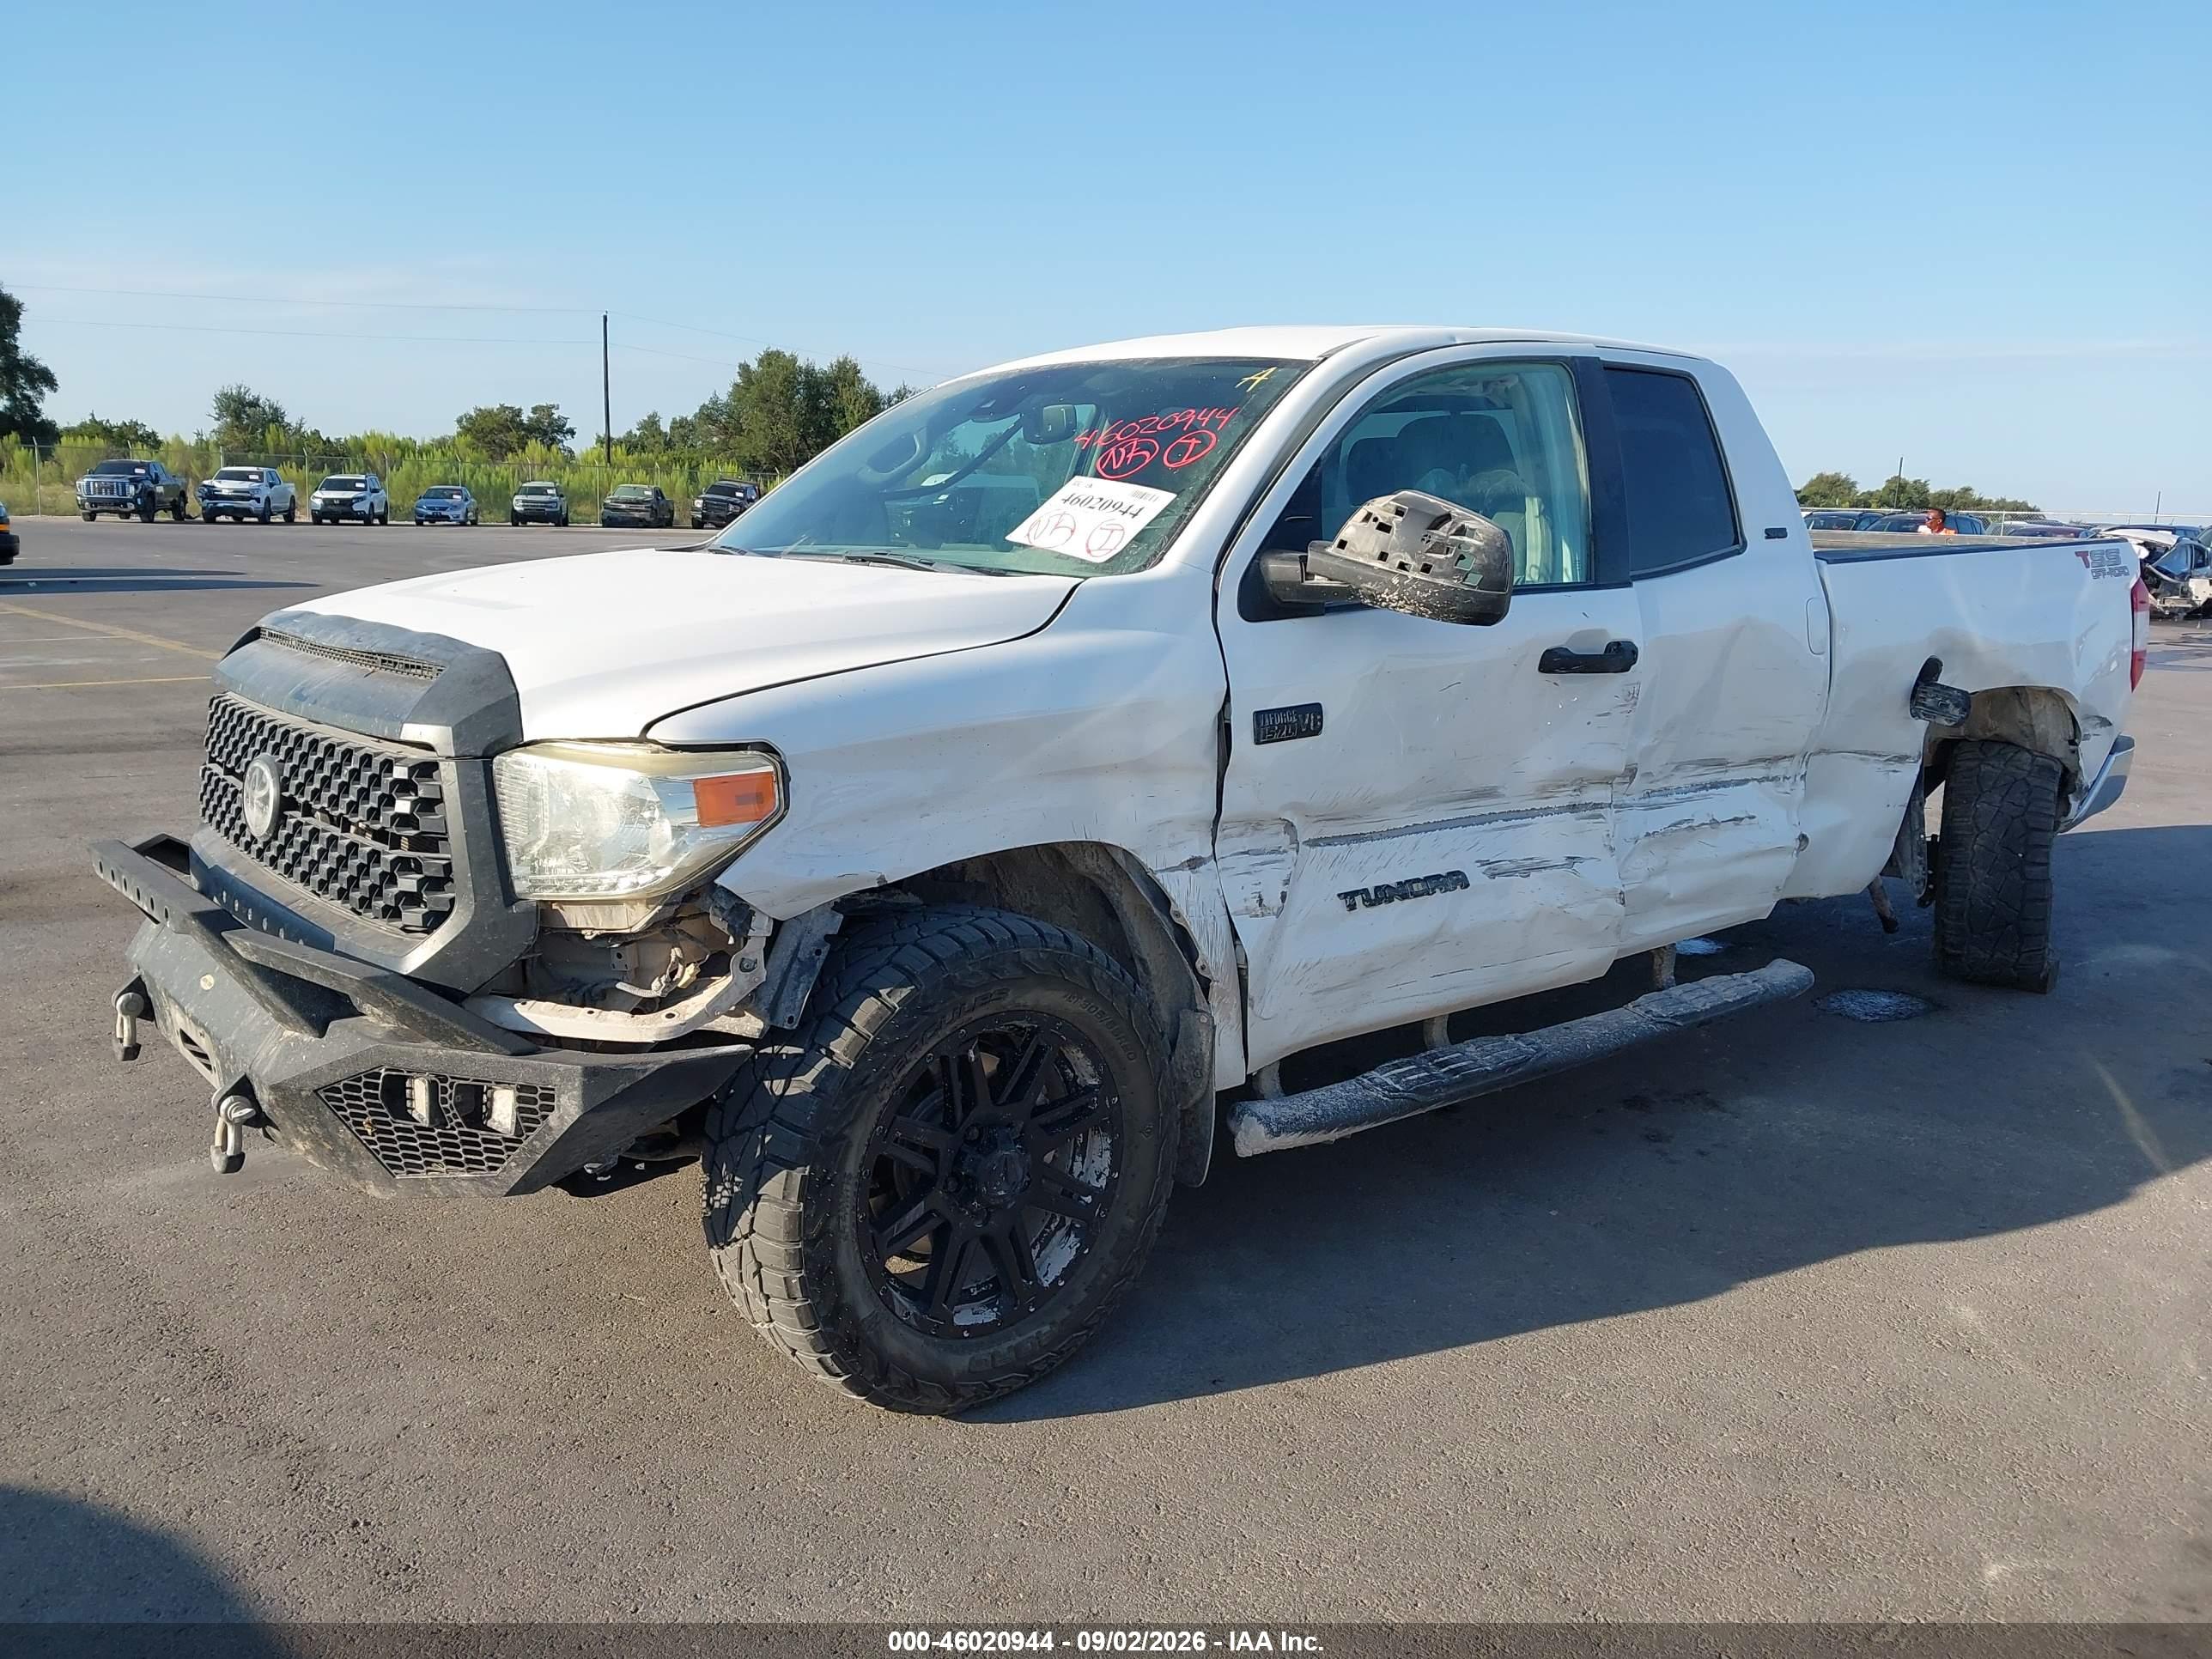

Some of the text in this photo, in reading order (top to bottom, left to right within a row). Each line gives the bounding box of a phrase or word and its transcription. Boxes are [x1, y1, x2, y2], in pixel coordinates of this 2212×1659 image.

[1074, 407, 1239, 449] 46020944
[1061, 492, 1146, 520] 46020944
[1337, 870, 1471, 912] TUNDRA
